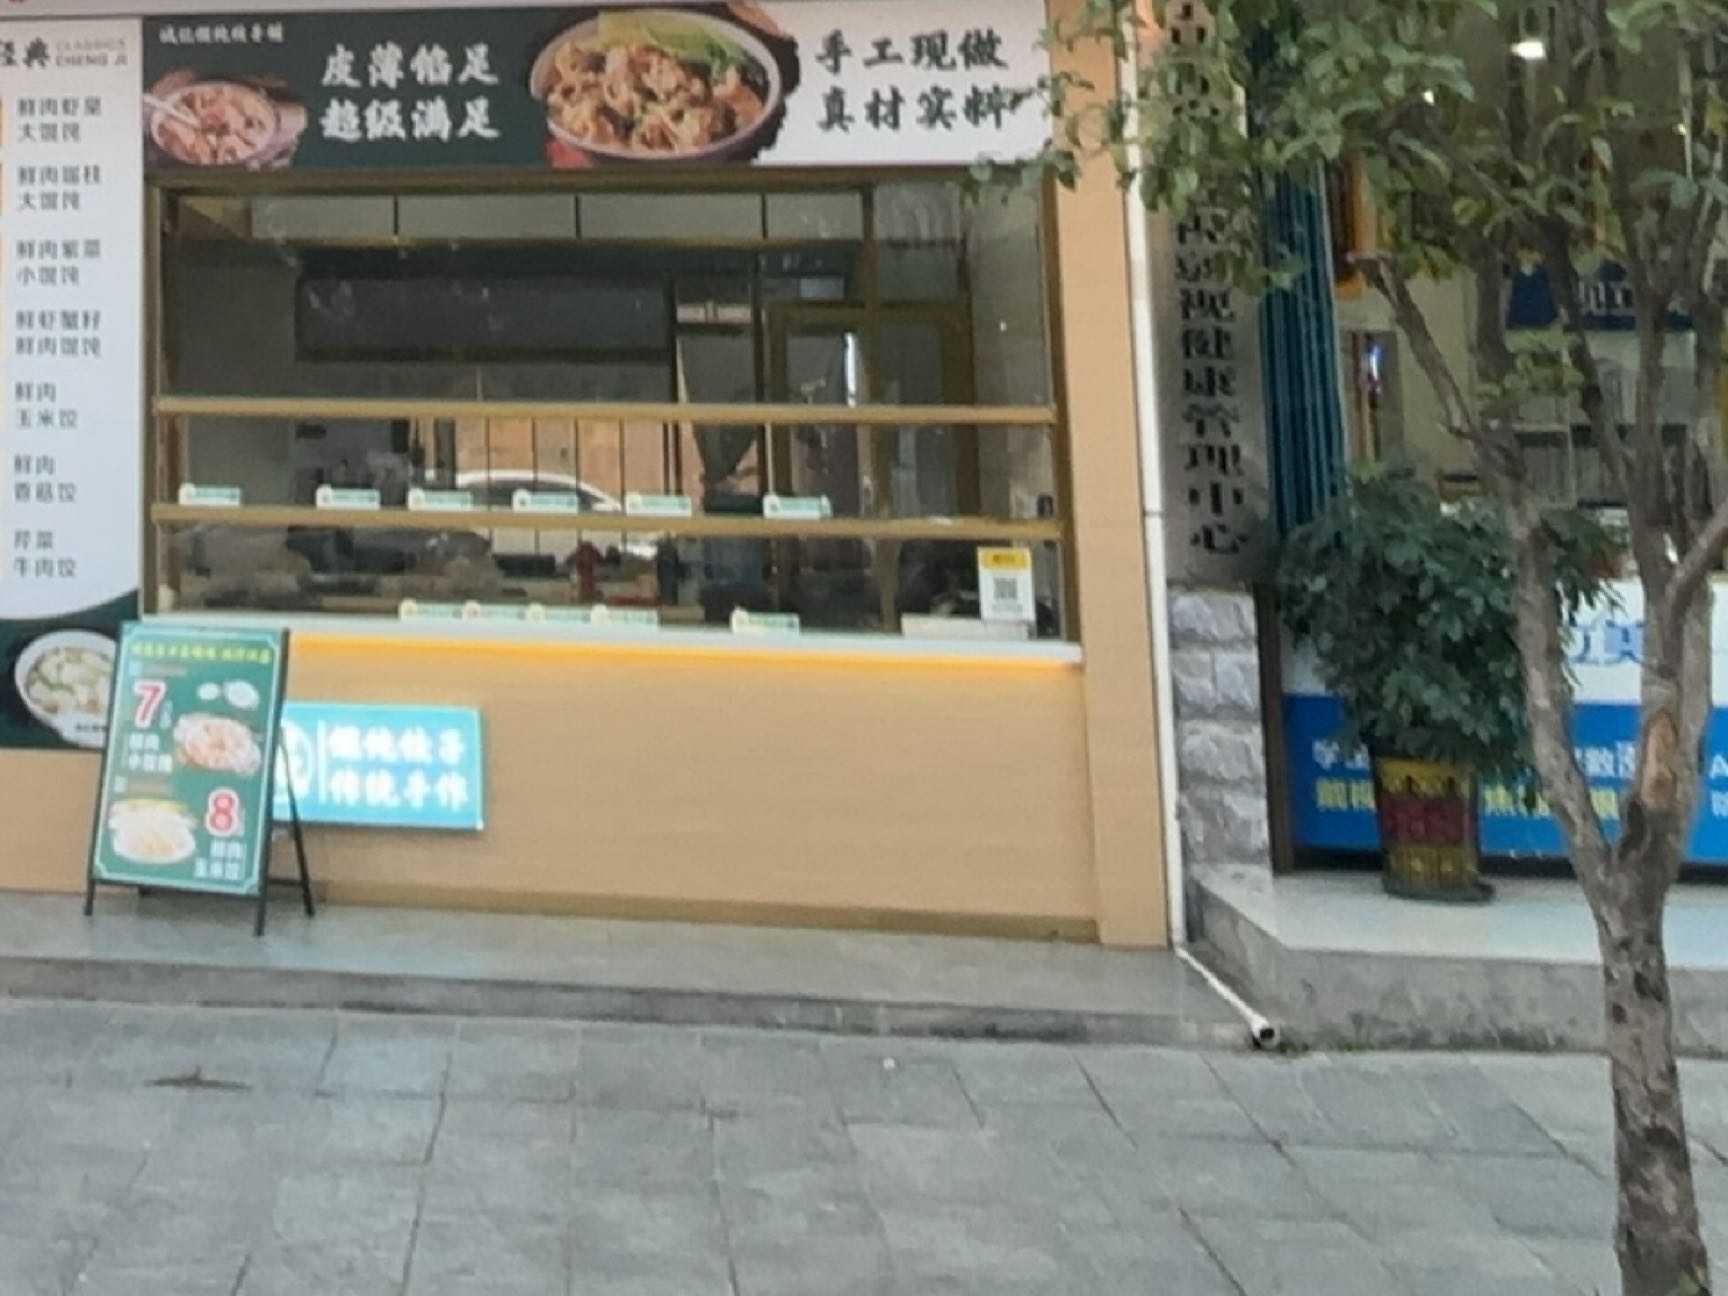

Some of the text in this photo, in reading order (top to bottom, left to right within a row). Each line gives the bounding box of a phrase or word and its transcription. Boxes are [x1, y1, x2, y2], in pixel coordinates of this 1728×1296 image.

[321, 42, 500, 88] 皮薄馅足
[814, 27, 1009, 75] 手工现做
[815, 84, 1006, 134] 真材实料
[133, 678, 167, 730] 7
[205, 786, 241, 838] 8
